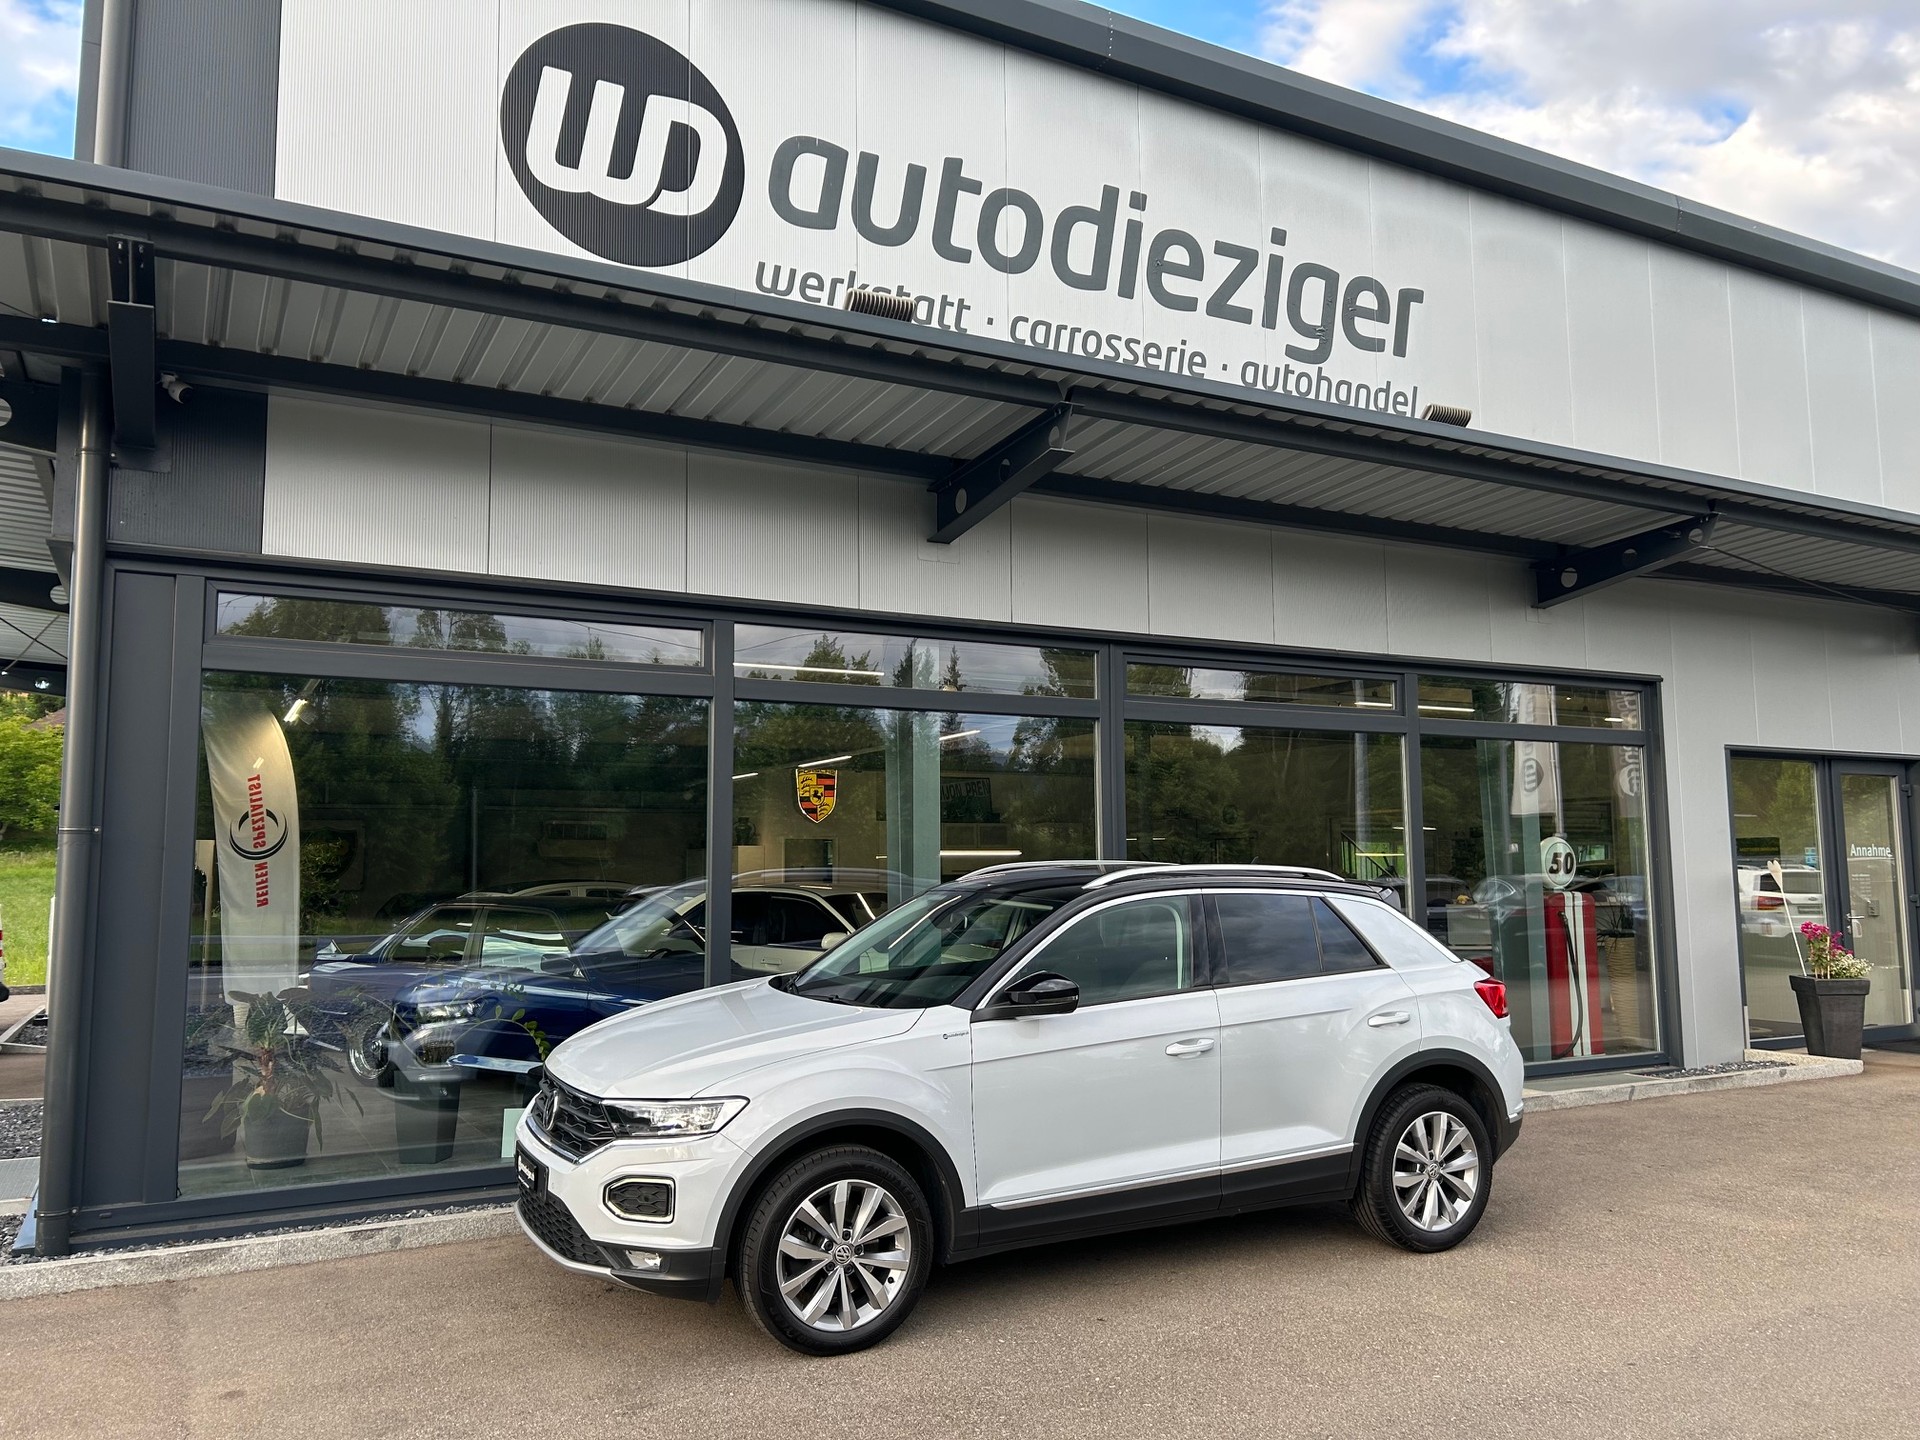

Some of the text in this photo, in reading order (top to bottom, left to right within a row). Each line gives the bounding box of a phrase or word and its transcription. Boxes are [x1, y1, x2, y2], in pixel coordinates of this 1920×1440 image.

[768, 135, 1424, 365] autodieziger
[1010, 314, 1207, 378] carrosserie
[1241, 359, 1418, 418] autohandel
[1549, 851, 1574, 874] 50
[1850, 843, 1891, 857] Annahme
